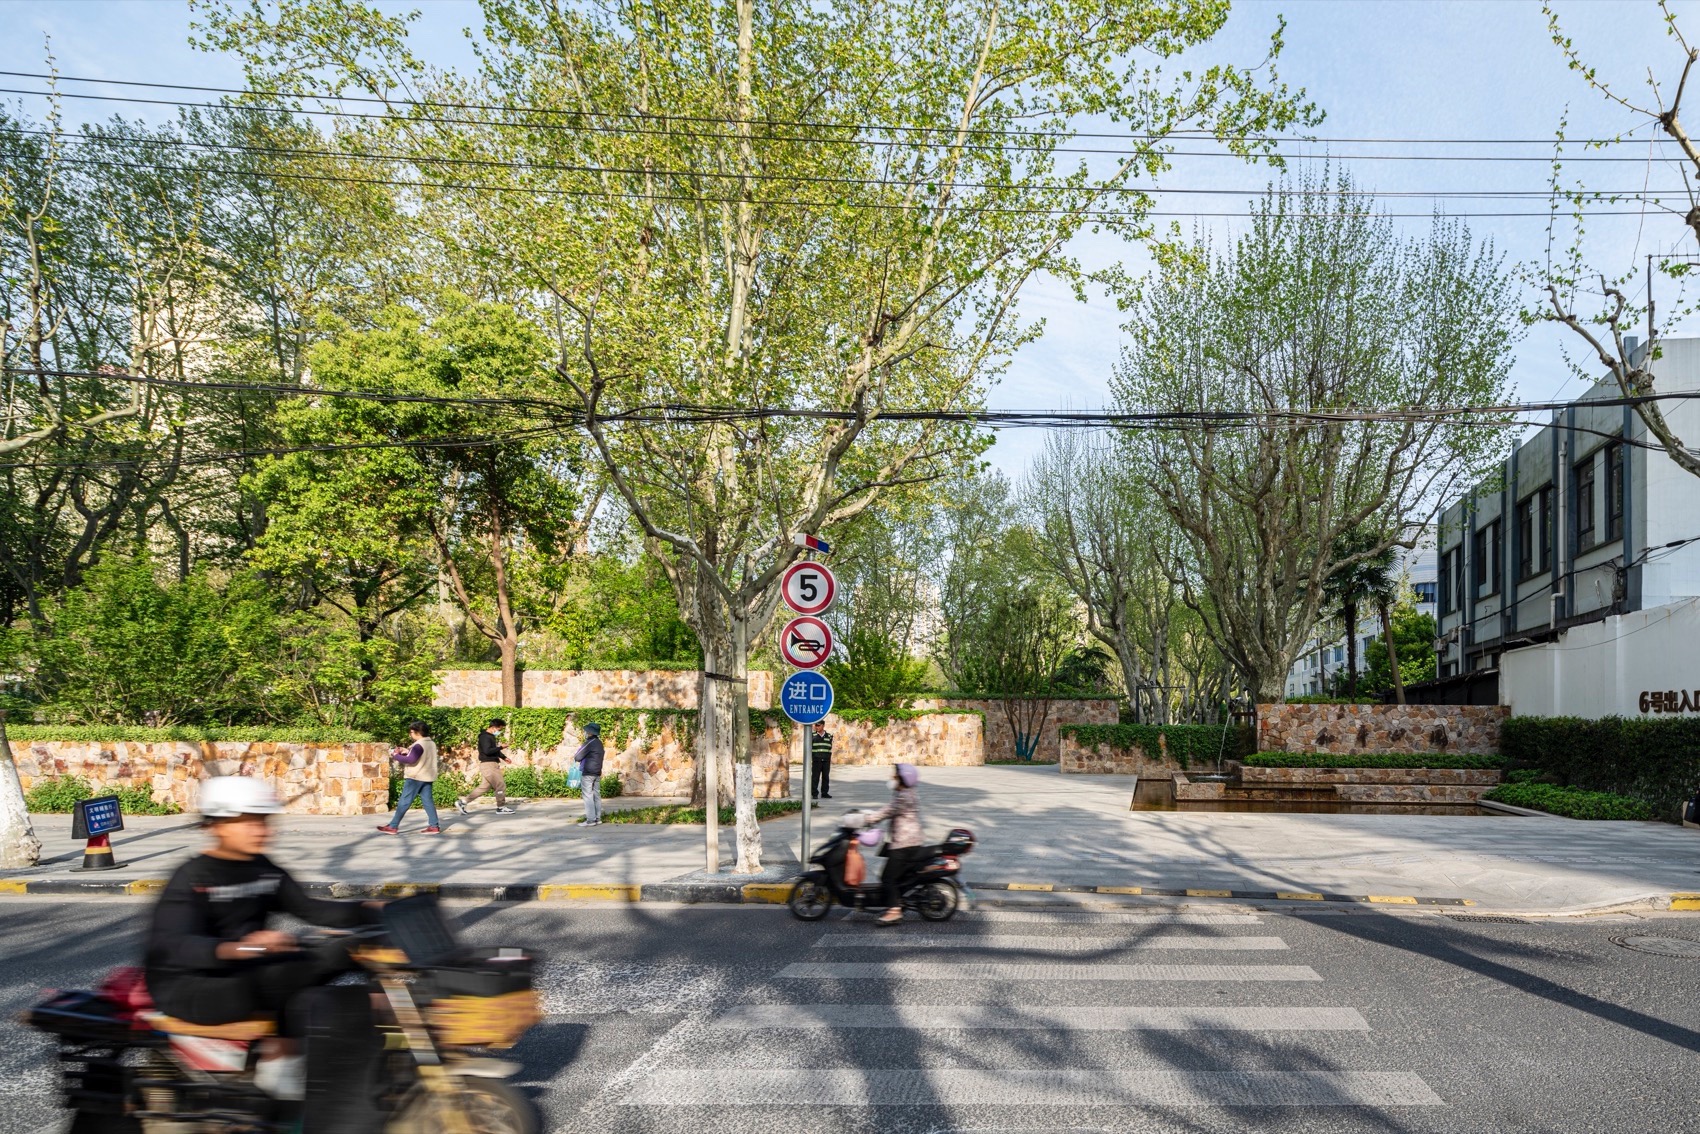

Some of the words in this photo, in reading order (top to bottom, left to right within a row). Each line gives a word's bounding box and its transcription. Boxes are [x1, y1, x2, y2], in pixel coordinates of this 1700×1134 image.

[800, 574, 818, 602] 5
[788, 681, 827, 701] 进口
[789, 704, 824, 715] ENTRANCE
